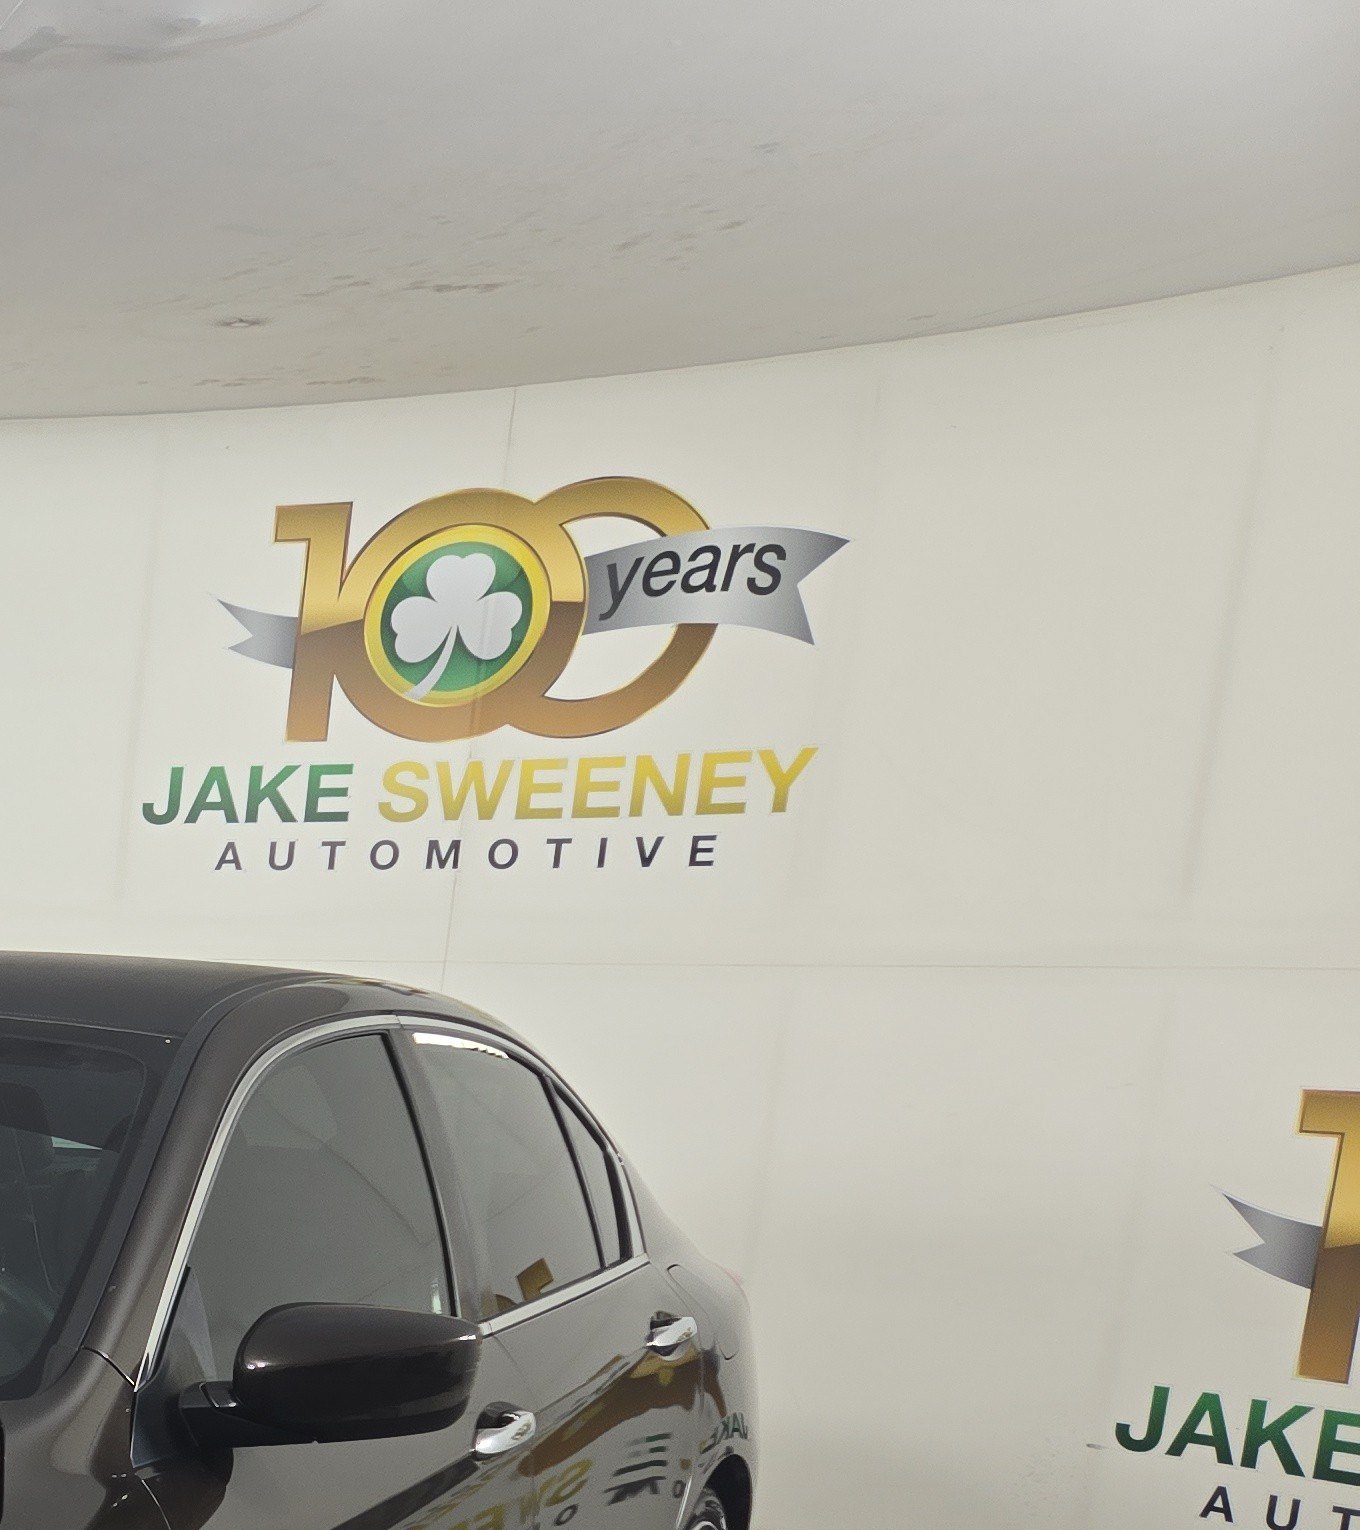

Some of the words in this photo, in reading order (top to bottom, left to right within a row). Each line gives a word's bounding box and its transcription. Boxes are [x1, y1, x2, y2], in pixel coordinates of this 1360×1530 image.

[599, 540, 788, 621] years
[141, 763, 354, 825] JAKE
[378, 746, 819, 824] SWEENEY
[215, 834, 719, 872] AUTOMOTIVE
[1115, 1385, 1360, 1486] JAKE
